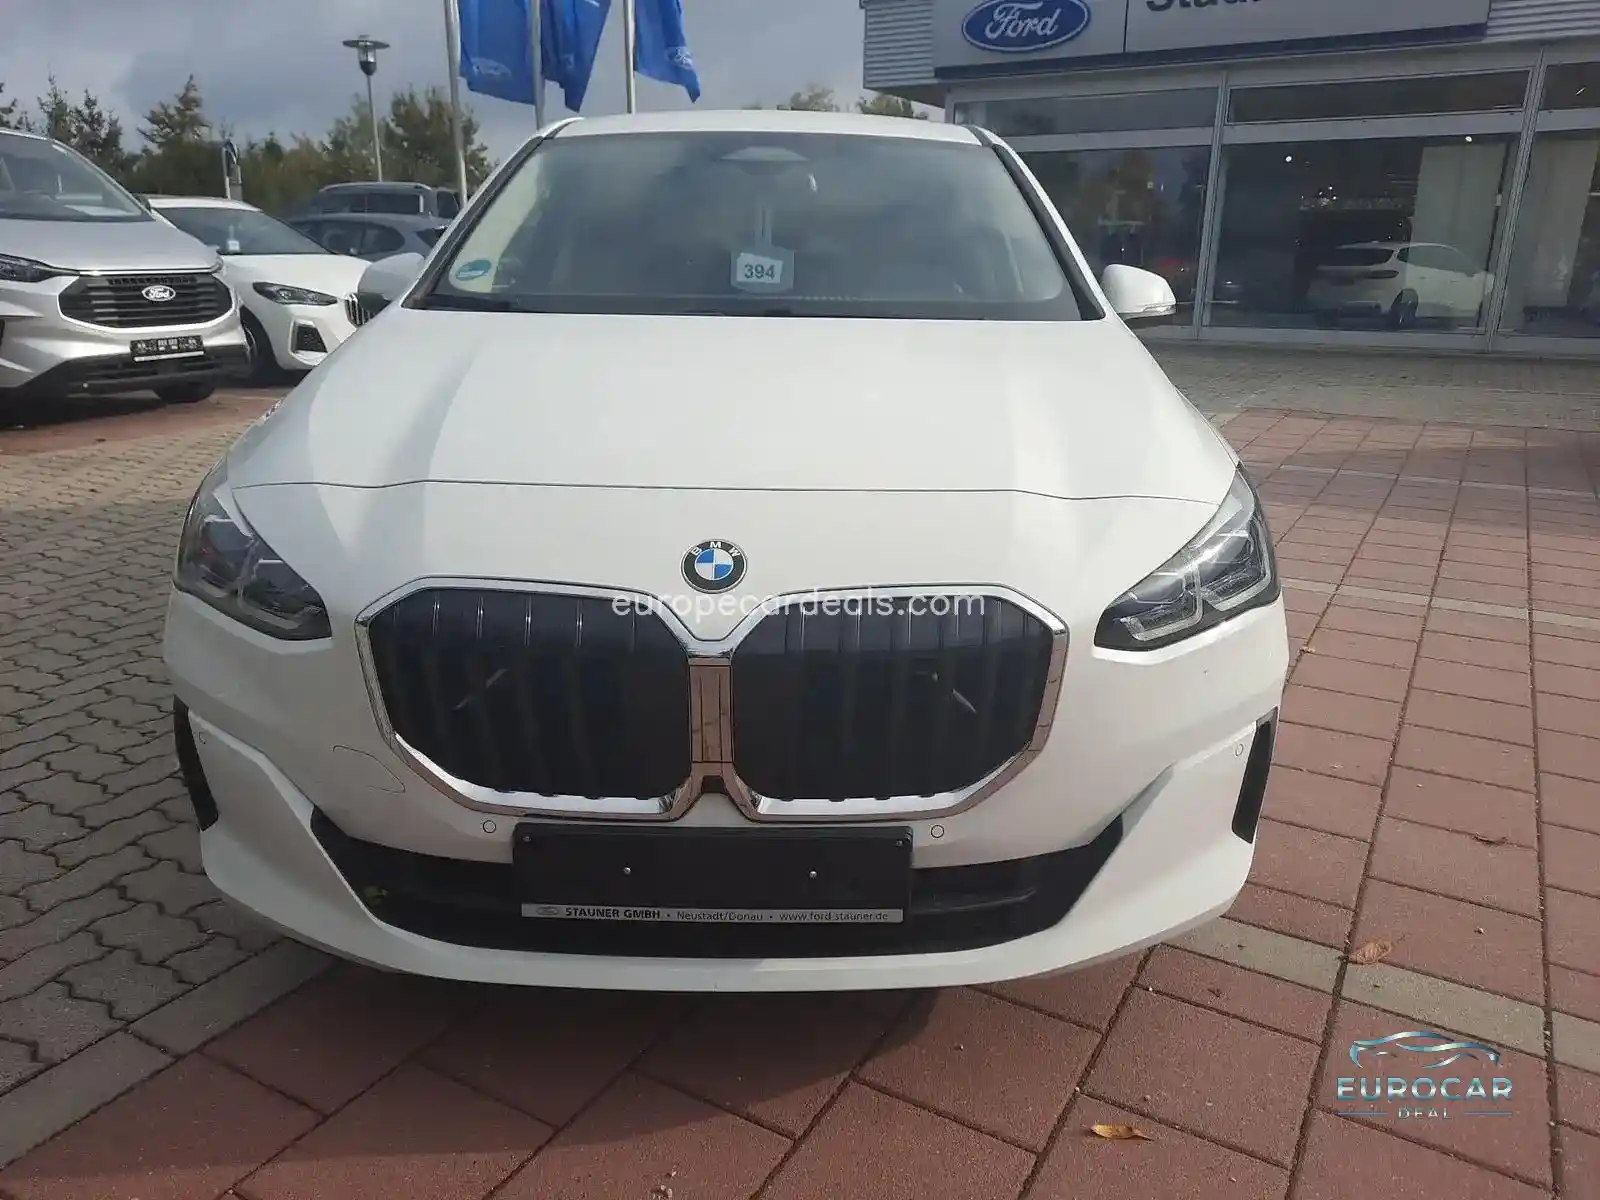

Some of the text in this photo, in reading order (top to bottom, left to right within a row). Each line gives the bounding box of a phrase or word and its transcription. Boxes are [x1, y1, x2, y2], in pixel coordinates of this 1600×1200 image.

[985, 2, 1062, 39] Ford
[744, 263, 775, 280] 394
[690, 541, 741, 557] BMW
[565, 907, 620, 918] STAUNER
[623, 908, 660, 919] GMBH
[676, 911, 763, 922] Neustadt/Donau
